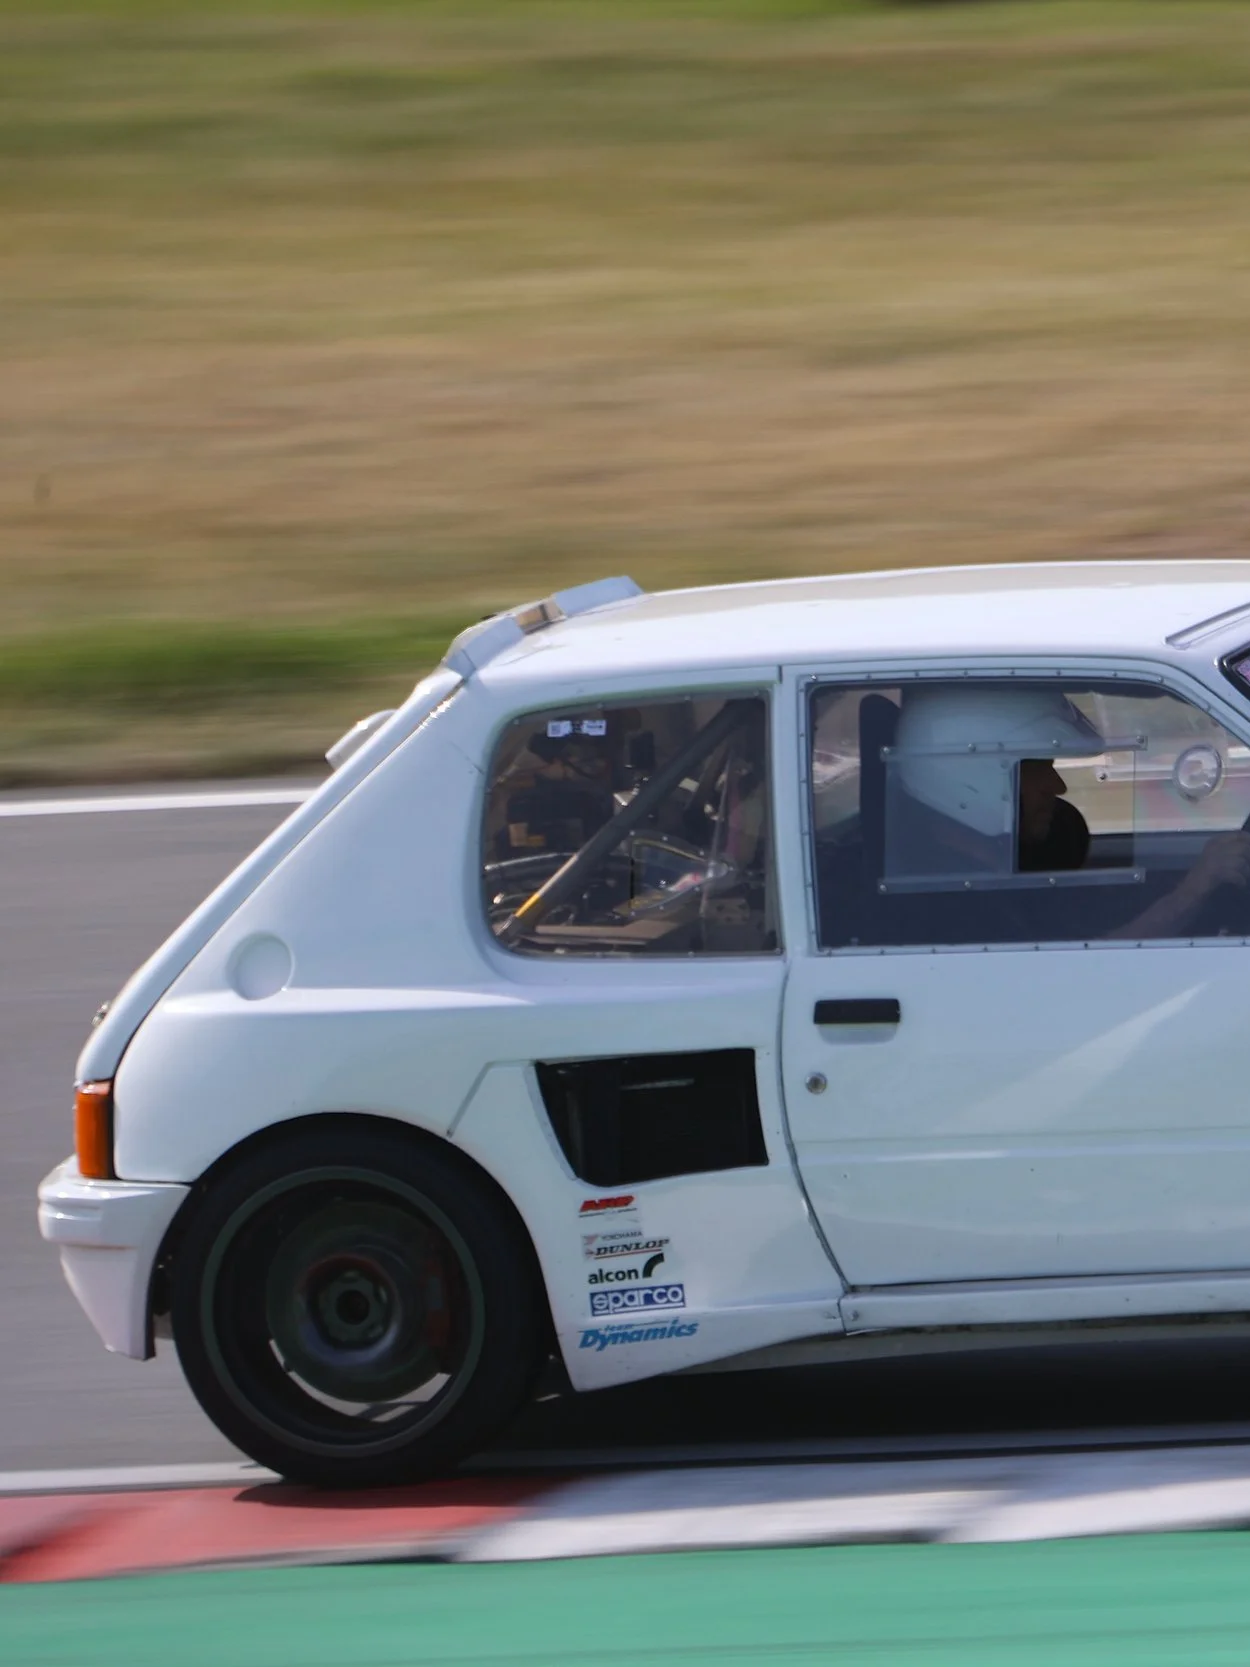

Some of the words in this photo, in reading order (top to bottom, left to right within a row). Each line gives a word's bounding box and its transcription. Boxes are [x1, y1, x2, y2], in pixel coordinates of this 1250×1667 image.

[595, 1238, 670, 1256] DUNLOP
[588, 1268, 639, 1285] alcon
[592, 1285, 683, 1314] sparco
[578, 1316, 700, 1352] Dynamics
